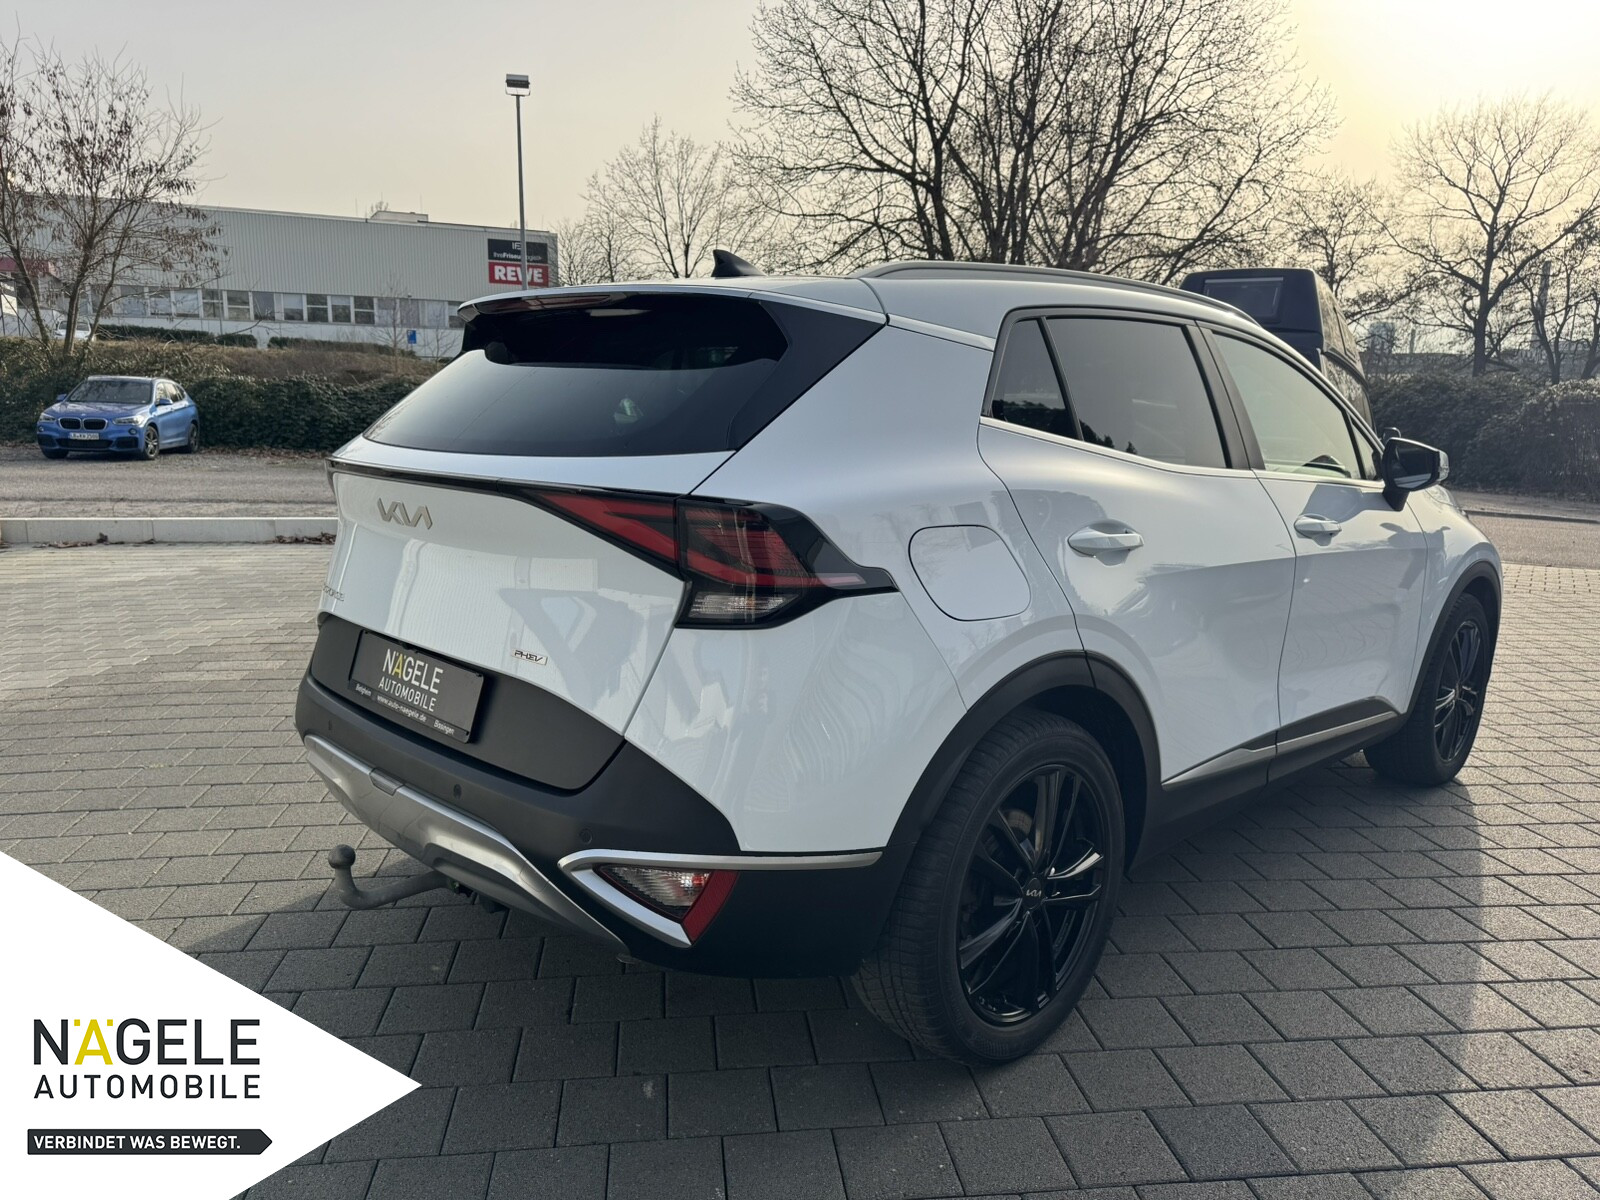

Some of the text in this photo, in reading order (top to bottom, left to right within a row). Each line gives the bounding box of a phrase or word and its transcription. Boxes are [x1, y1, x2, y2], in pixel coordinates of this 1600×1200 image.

[494, 265, 543, 283] REWE
[377, 497, 433, 530] KIA
[382, 648, 443, 694] NÄGELE
[514, 650, 543, 662] PHEV
[377, 695, 427, 723] www.auto-naegele.de
[378, 676, 436, 712] AUTOMOBILE
